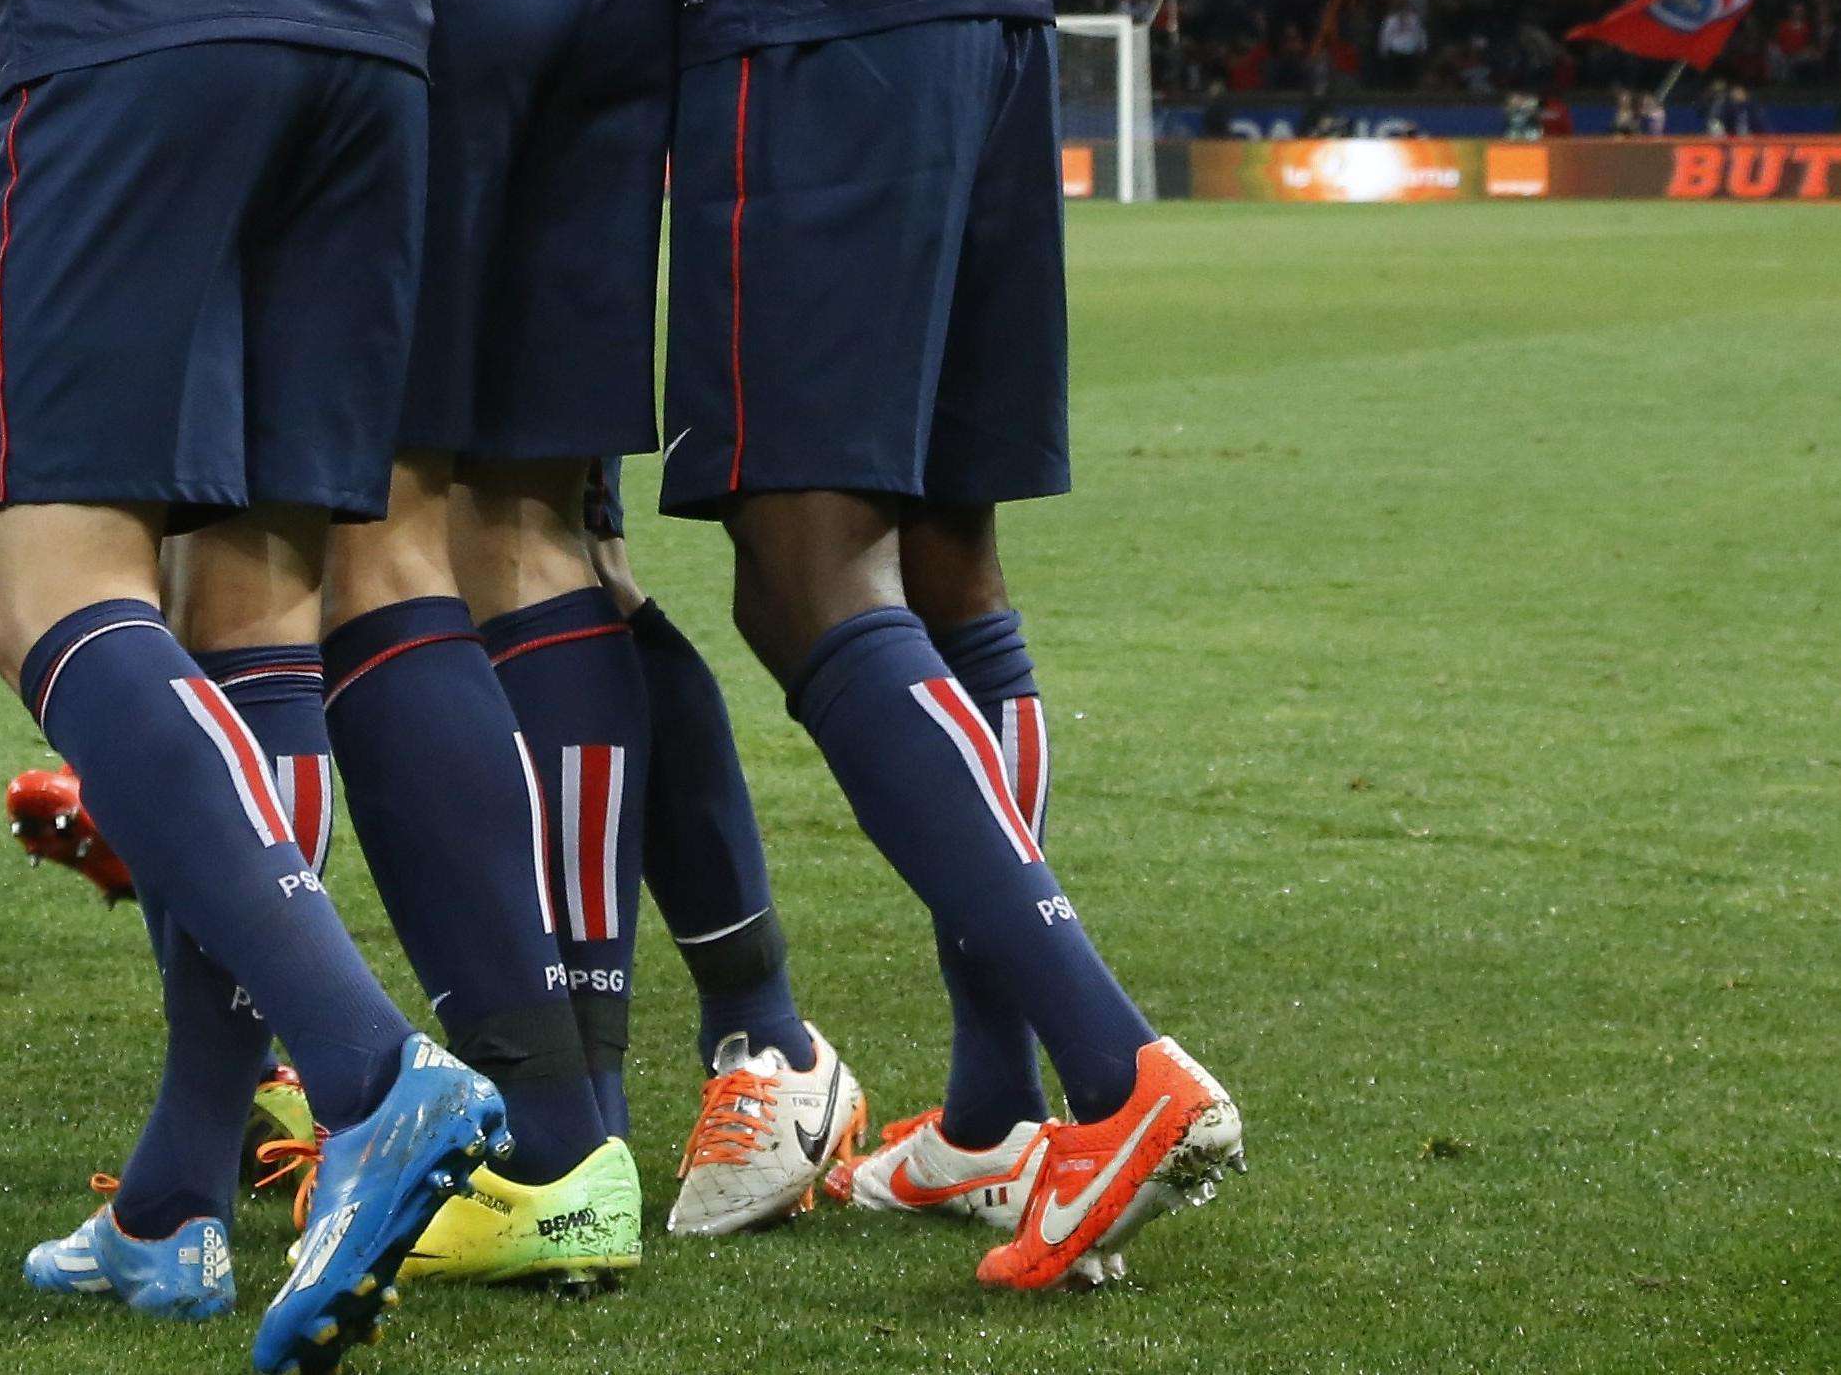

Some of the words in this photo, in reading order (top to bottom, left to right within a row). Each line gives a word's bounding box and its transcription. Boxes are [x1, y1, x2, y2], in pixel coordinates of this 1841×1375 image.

[1667, 143, 1841, 199] BUT
[278, 870, 328, 900] PS
[1037, 894, 1077, 926] PS
[544, 962, 568, 992] PS
[569, 969, 625, 994] PSG
